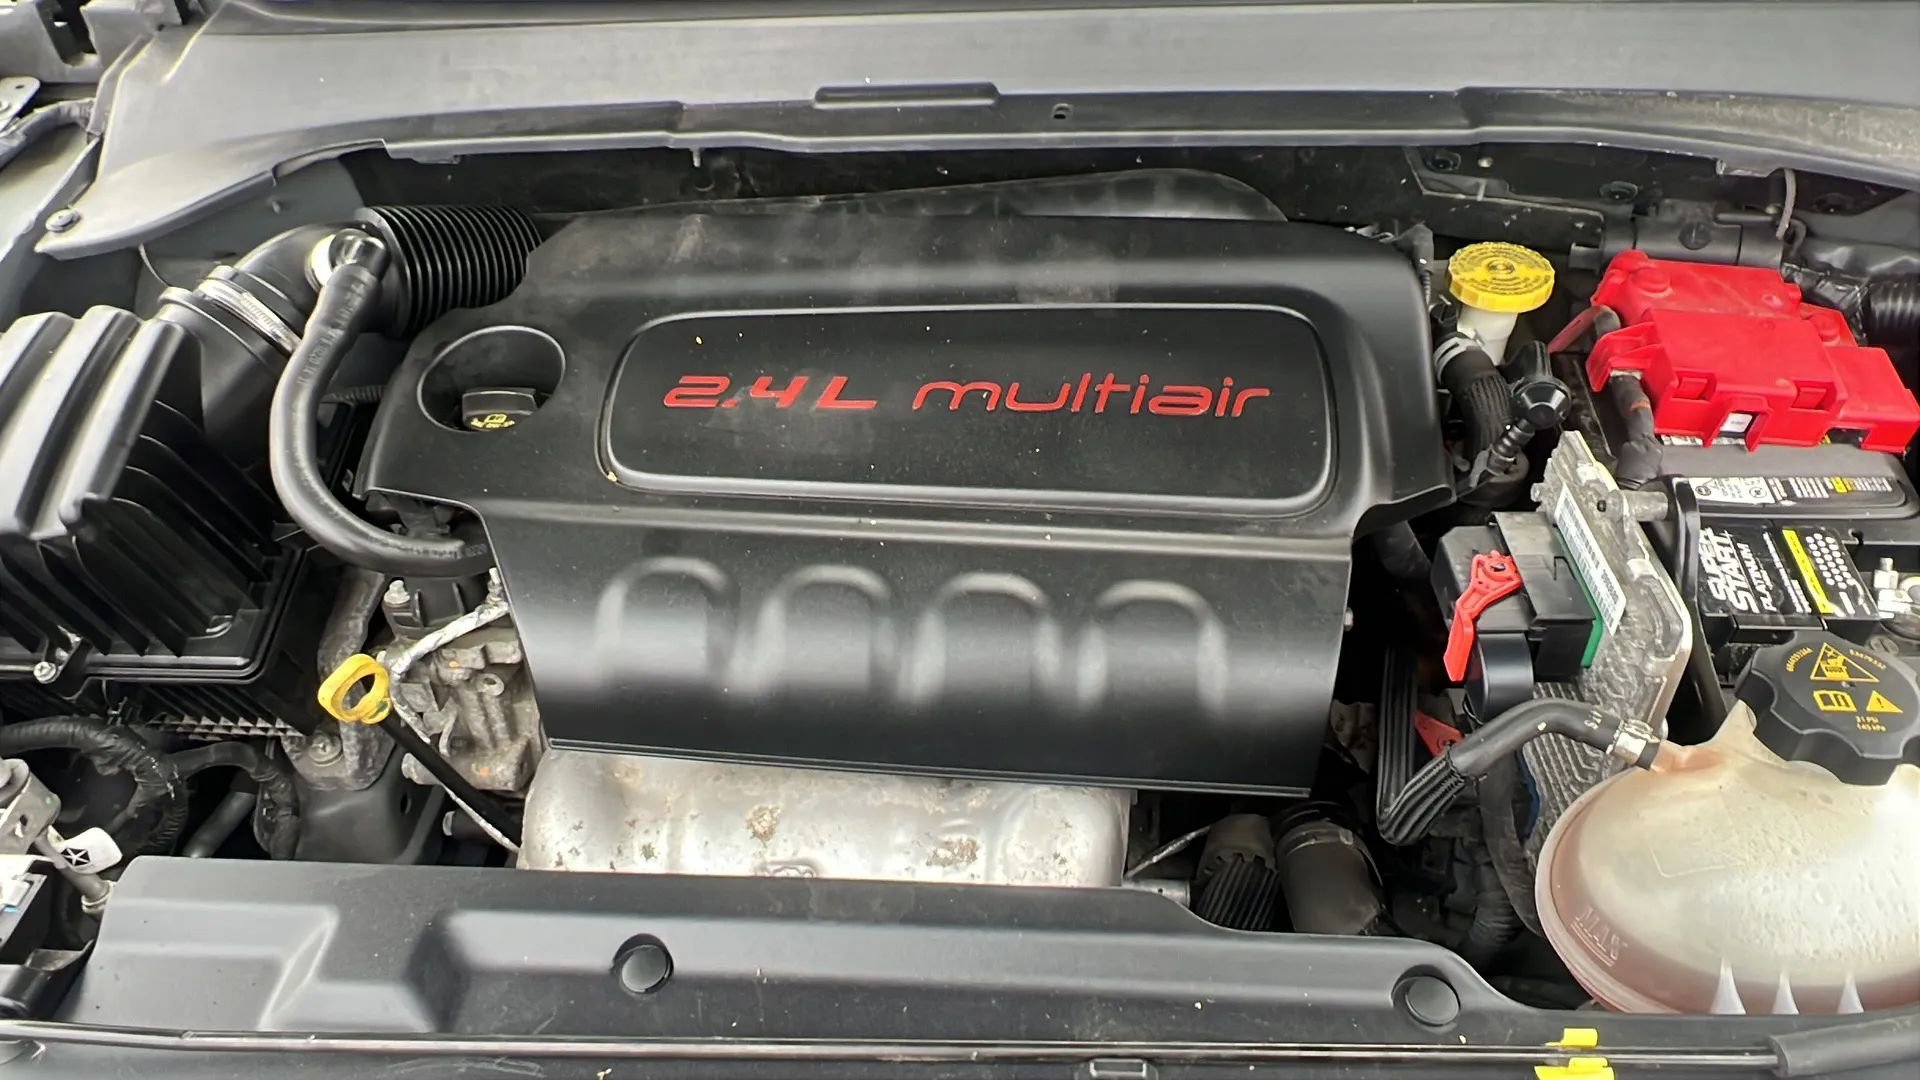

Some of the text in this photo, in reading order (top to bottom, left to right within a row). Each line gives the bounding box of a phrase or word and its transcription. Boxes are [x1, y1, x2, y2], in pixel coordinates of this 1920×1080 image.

[663, 372, 1272, 418] 2.4L multiair
[1698, 527, 1727, 601] SUPER
[1713, 533, 1760, 614] START
[1736, 542, 1778, 612] PLATINUM
